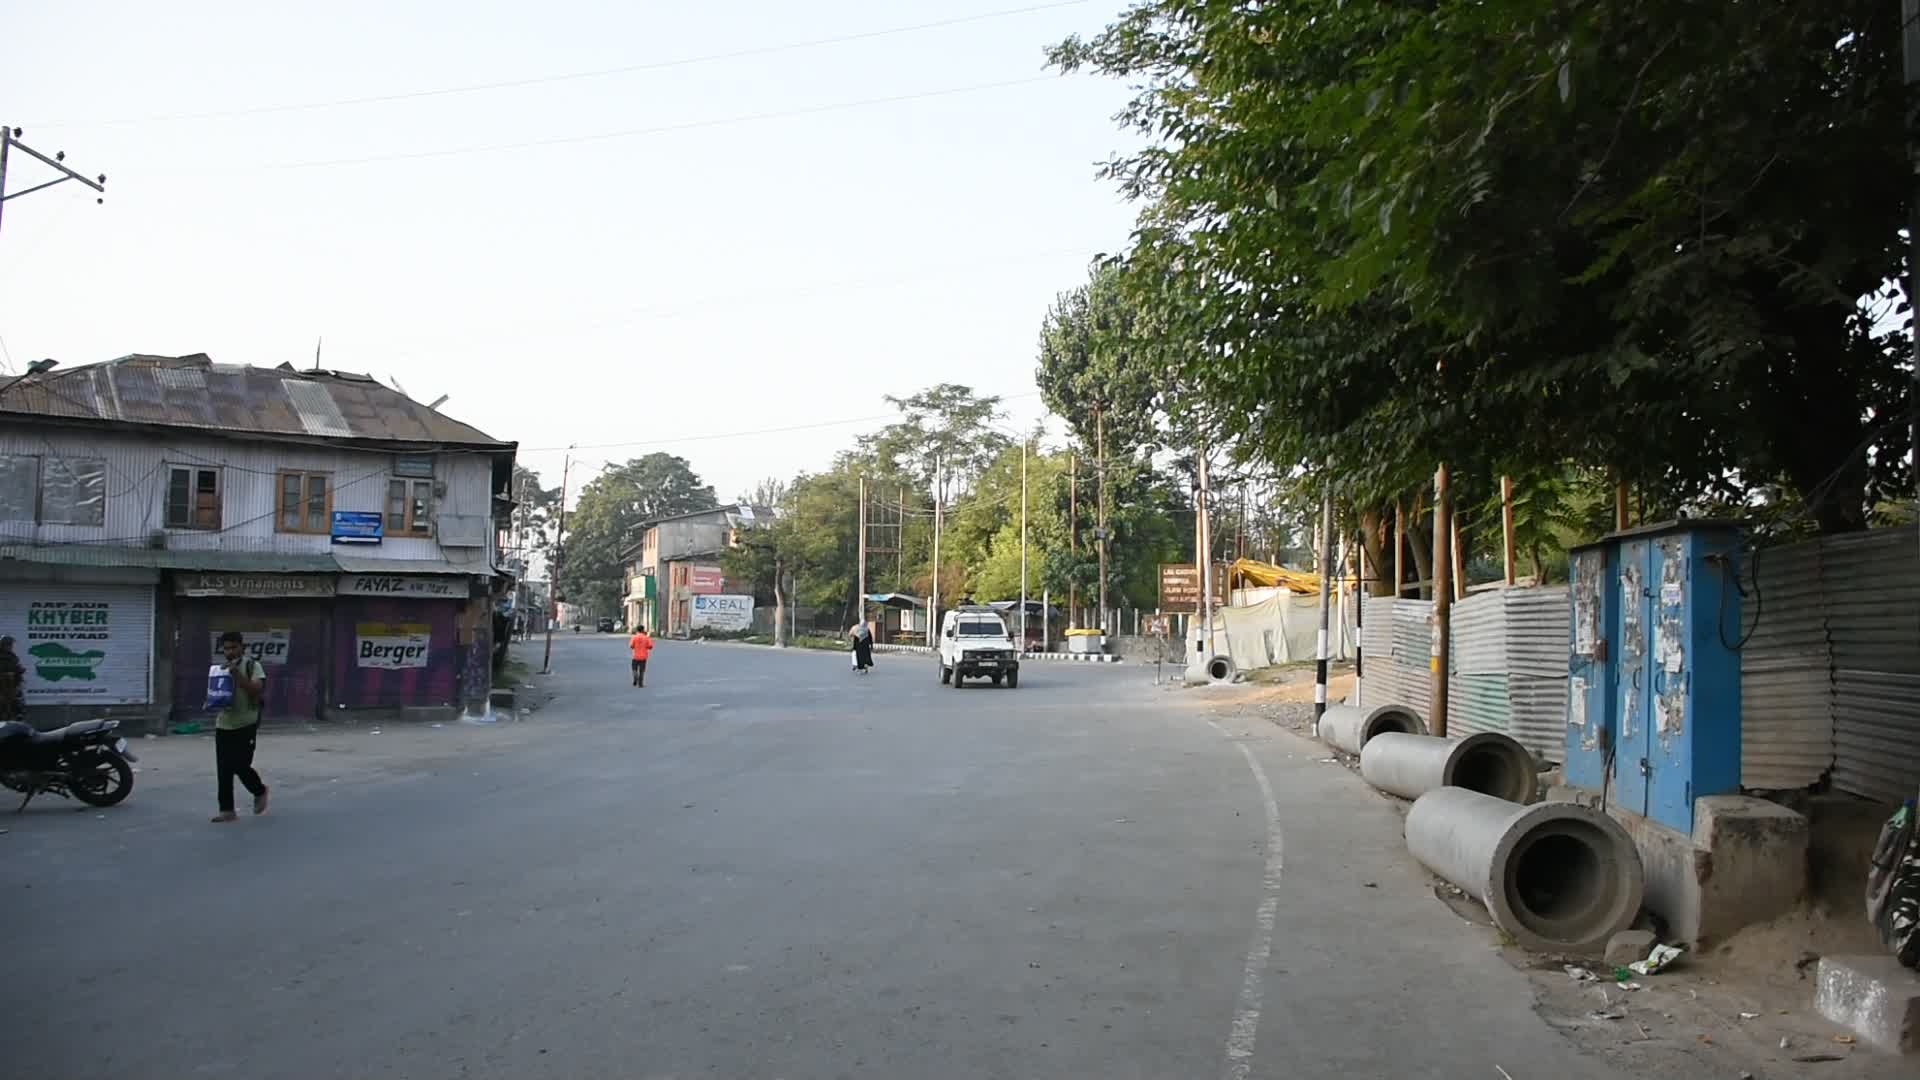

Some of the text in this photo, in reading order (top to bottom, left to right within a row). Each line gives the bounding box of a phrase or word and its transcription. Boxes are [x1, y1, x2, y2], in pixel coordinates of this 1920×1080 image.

[229, 577, 305, 590] Ornaments
[354, 577, 404, 593] FAYAZ
[28, 609, 108, 625] KHYBER
[214, 637, 286, 661] Brger
[359, 640, 425, 664] Berger
